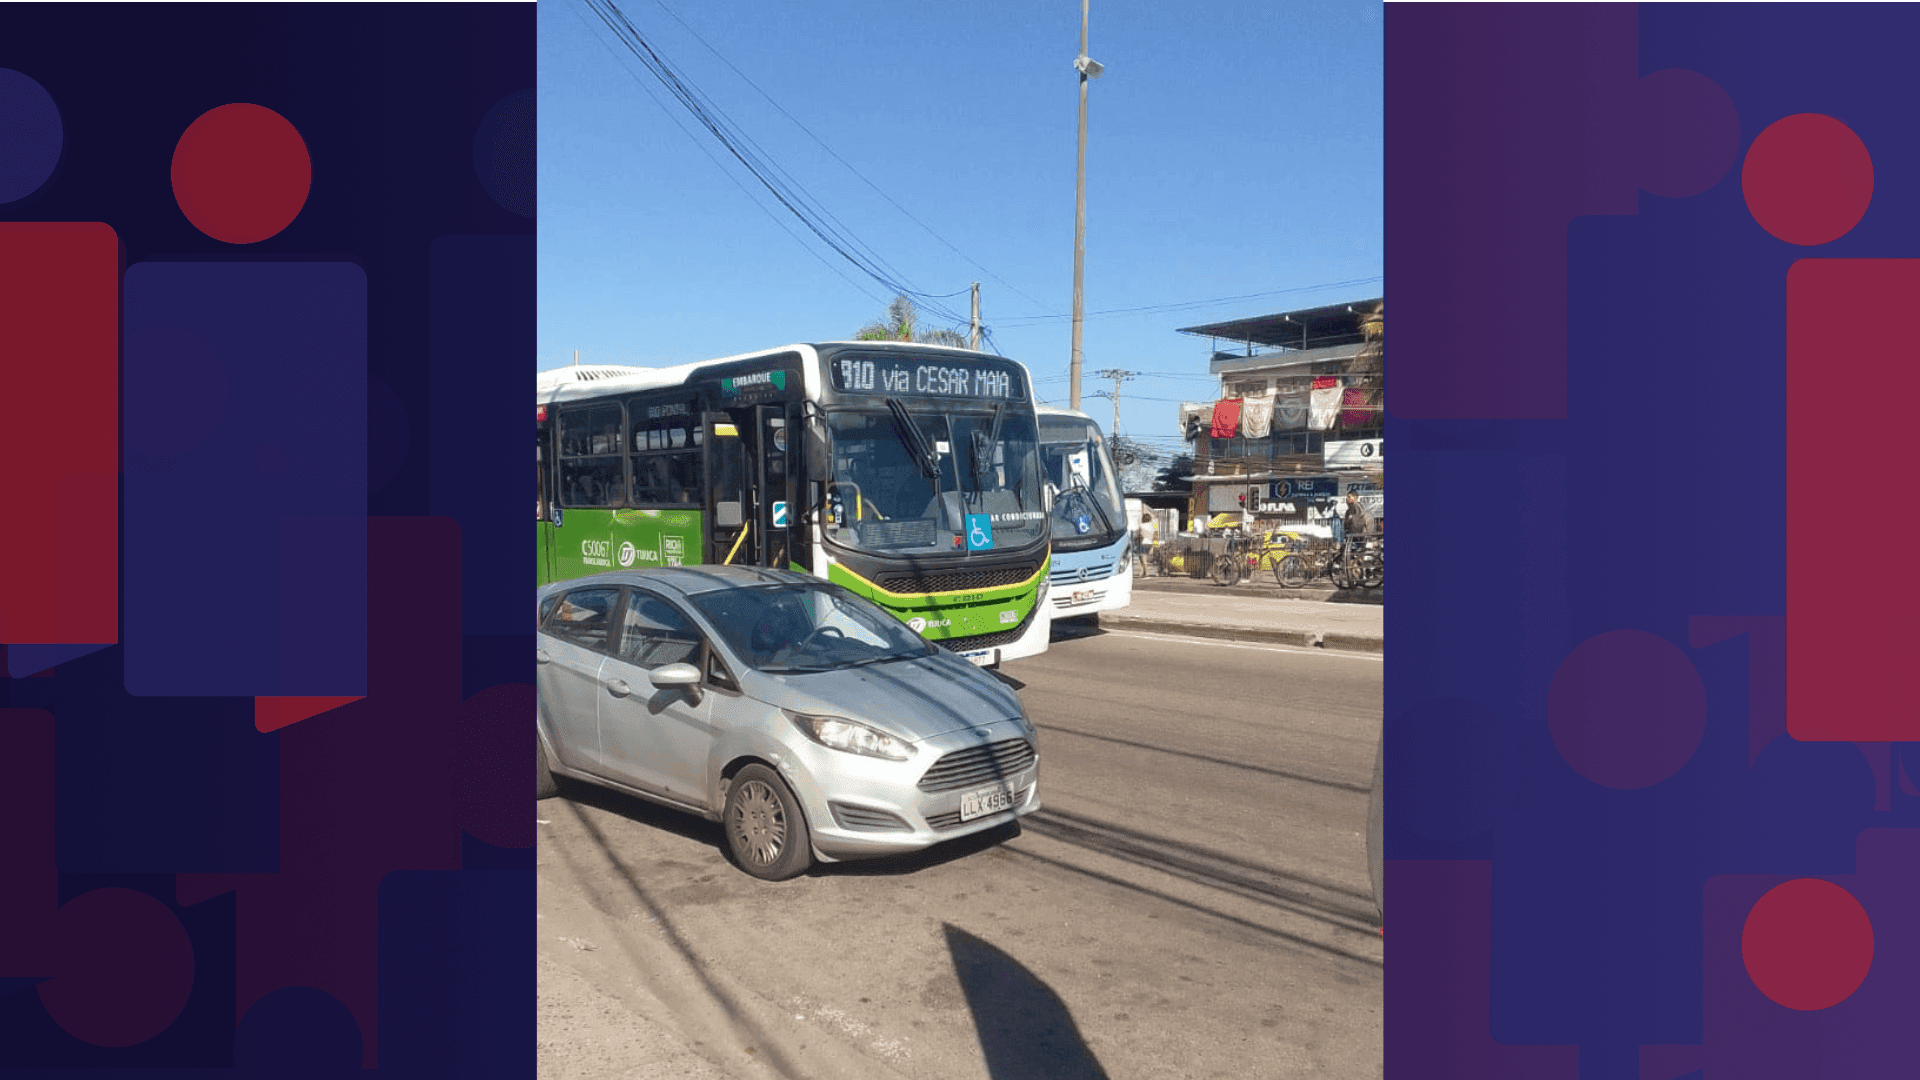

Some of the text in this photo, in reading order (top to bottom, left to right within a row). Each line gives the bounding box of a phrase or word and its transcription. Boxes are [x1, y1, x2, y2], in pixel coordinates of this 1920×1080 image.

[732, 371, 771, 388] EMBARQUE
[882, 364, 909, 392] via
[916, 365, 969, 396] CESAR
[975, 369, 1009, 398] MAIA
